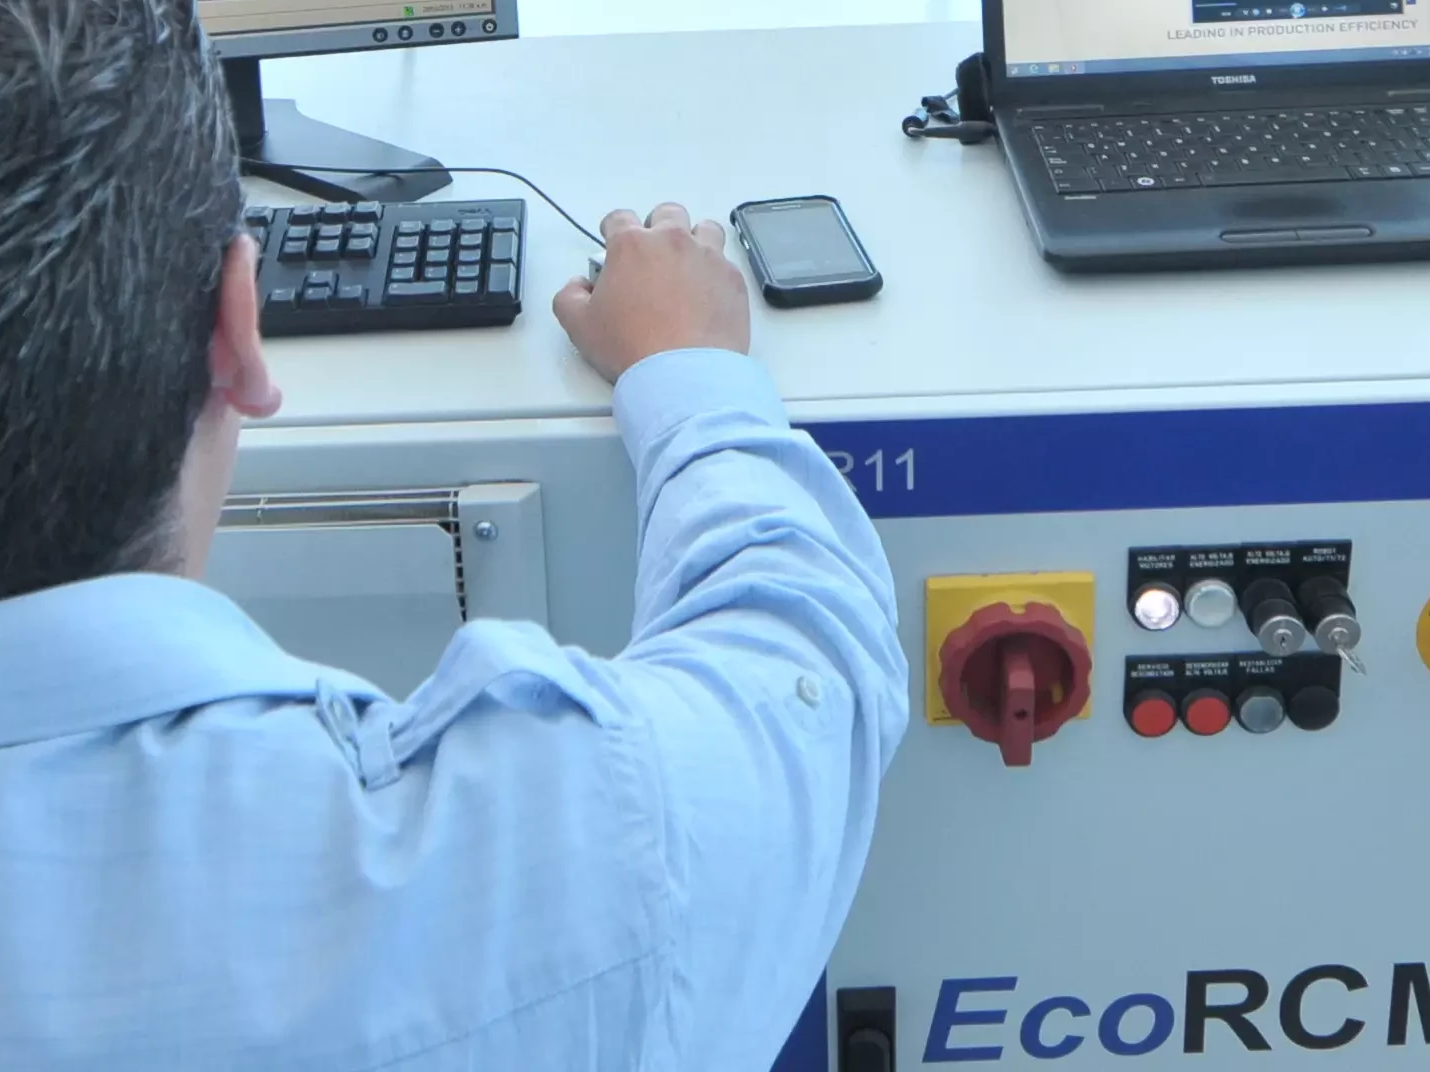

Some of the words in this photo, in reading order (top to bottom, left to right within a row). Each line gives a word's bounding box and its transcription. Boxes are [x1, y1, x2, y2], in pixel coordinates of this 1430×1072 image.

[1167, 27, 1225, 40] LEADING
[1230, 27, 1244, 38] IN
[1248, 23, 1335, 37] PRODUCTION
[1339, 19, 1419, 34] EFFICIENCY
[1211, 74, 1256, 85] TOSHIBA
